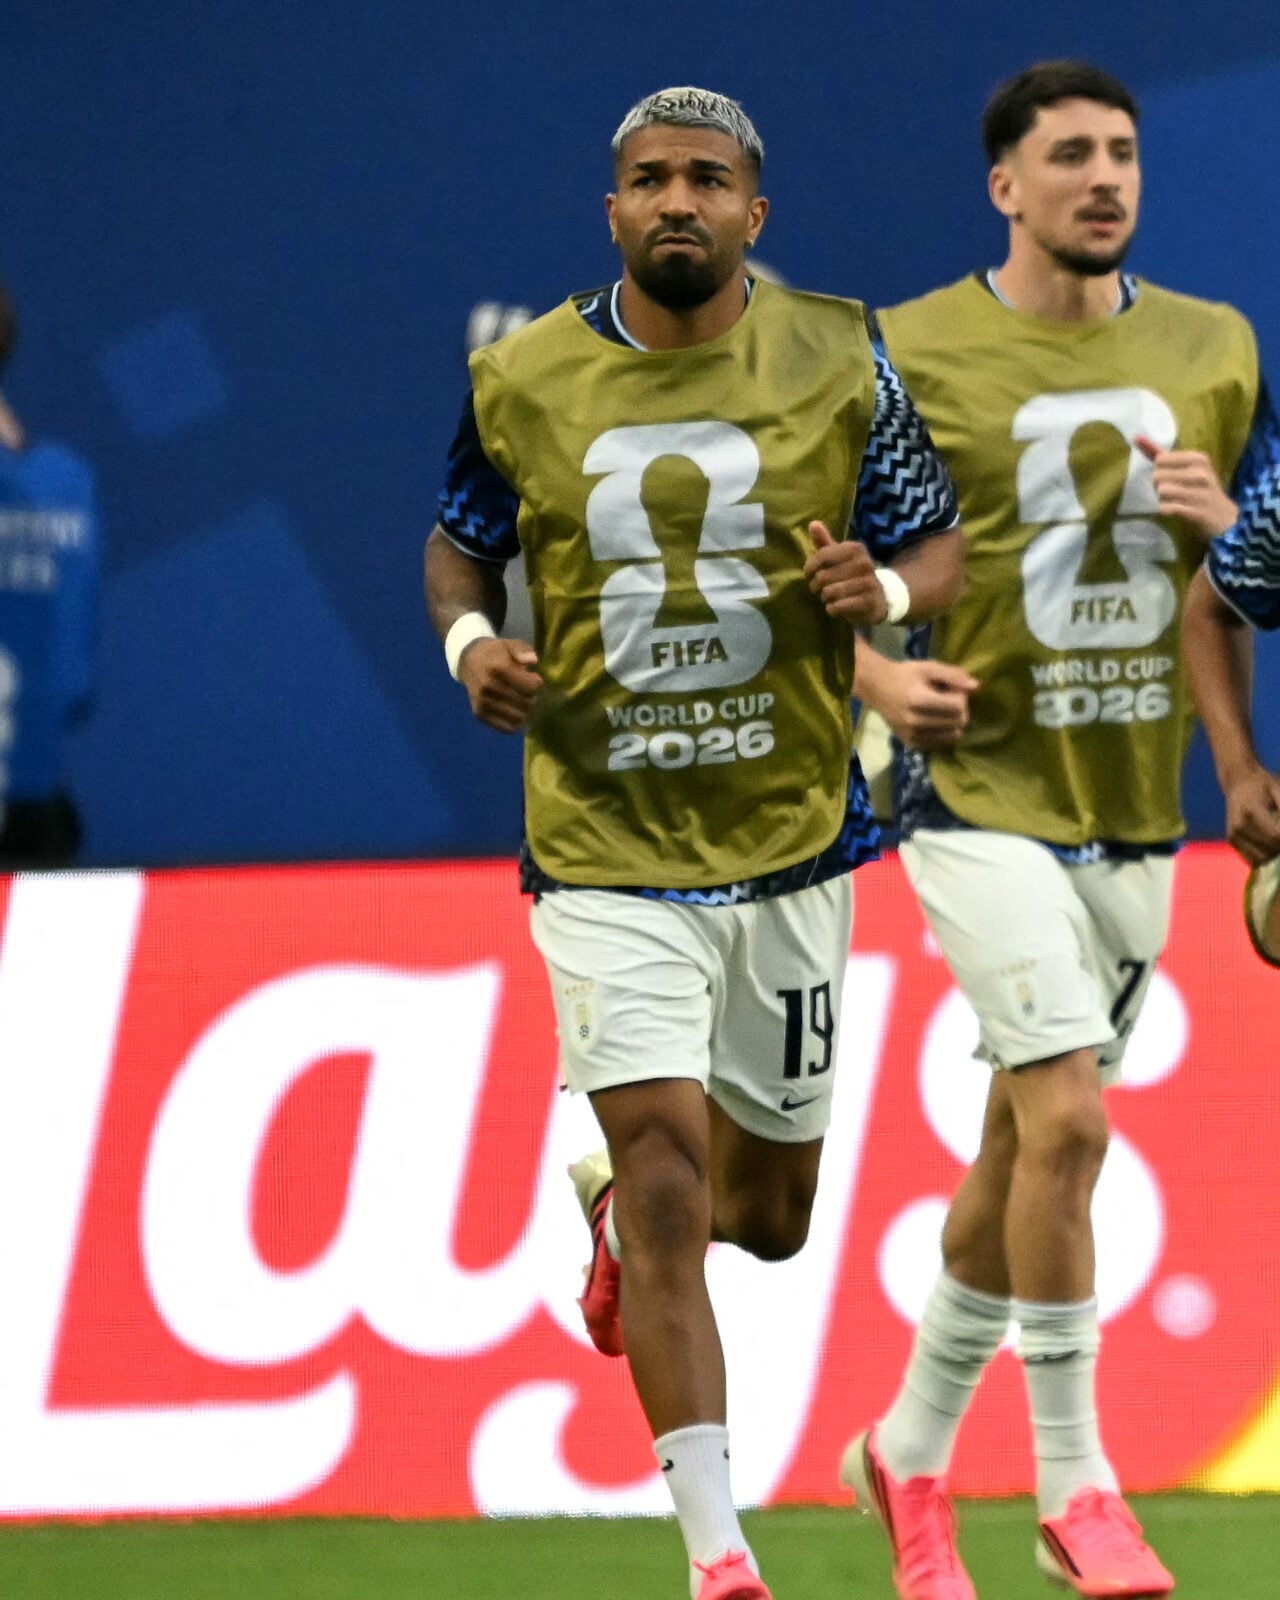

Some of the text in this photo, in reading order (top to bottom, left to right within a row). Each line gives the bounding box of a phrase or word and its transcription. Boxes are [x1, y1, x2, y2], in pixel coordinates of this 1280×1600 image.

[1070, 597, 1137, 625] FIFA
[650, 637, 728, 668] FIFA
[1031, 656, 1173, 686] WORLD CUP
[605, 692, 775, 728] WORLD CUP
[1032, 683, 1172, 729] 2026
[607, 720, 775, 771] 2026
[776, 980, 834, 1079] 19
